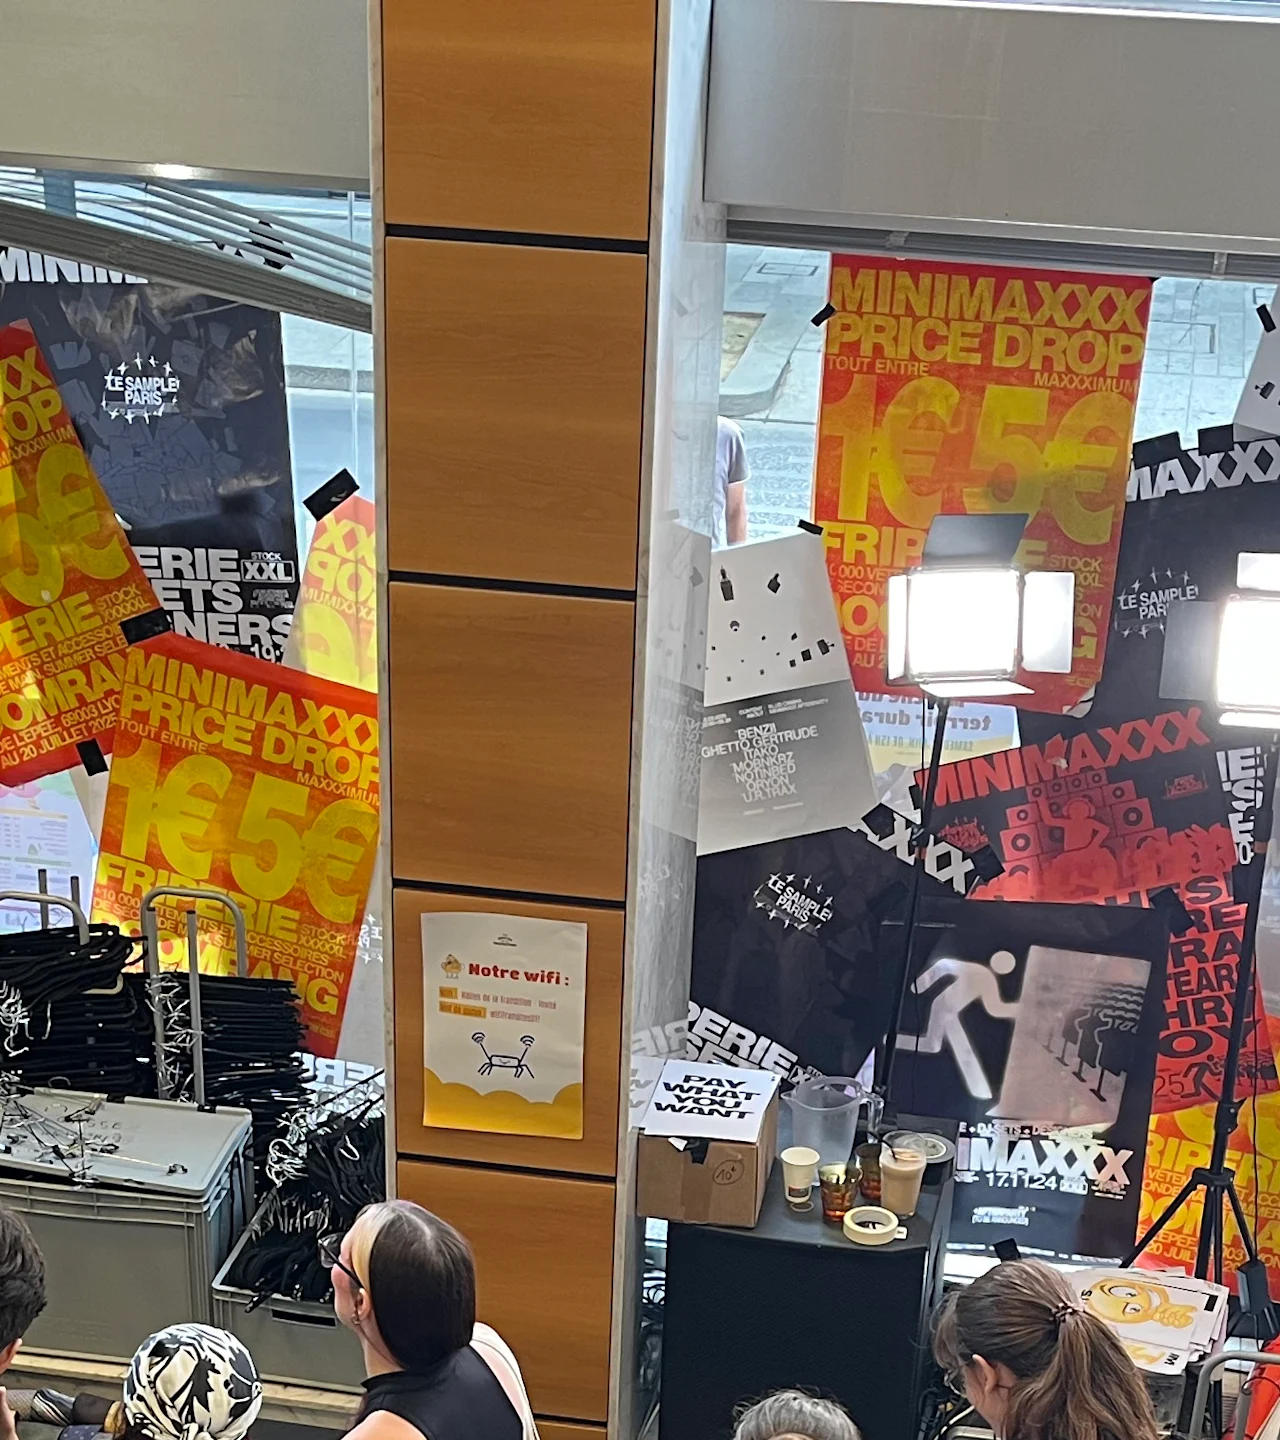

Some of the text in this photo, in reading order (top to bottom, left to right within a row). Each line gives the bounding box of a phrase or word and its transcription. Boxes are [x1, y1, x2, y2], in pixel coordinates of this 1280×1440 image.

[830, 267, 1149, 332] MINIMAXXX
[826, 312, 1148, 376] PRICE DROP
[827, 355, 930, 376] TOUT ENTRE
[107, 375, 177, 393] LE SAMPLE
[1034, 372, 1138, 393] MAXXXIMUM
[125, 391, 162, 406] PARIS
[820, 374, 1137, 545] 1€ 5€
[251, 551, 281, 561] STOCK
[1049, 555, 1102, 571] STOCK
[243, 561, 295, 582] XXL
[95, 583, 142, 610] STOCK
[1119, 586, 1196, 611] LE SAMPLE
[41, 649, 56, 663] ET
[44, 648, 96, 679] SUMMER
[62, 702, 98, 727] 69003
[121, 683, 256, 756] PRICE
[1, 750, 20, 768] AU
[21, 744, 40, 761] 20
[41, 725, 87, 754] JUILLET
[119, 718, 209, 755] TOUT ENTRE
[701, 726, 818, 758] GHETTO GERTRUDE
[230, 772, 380, 925] 5€
[768, 876, 831, 923] LE SAMPLE
[776, 896, 810, 923] PARIS
[94, 900, 345, 984] DE SELECTION
[300, 923, 346, 946] STOCK
[469, 963, 561, 985] Notre wifi
[663, 1082, 761, 1101] WHAT
[683, 1075, 747, 1089] PAY
[654, 1102, 754, 1119] WANT
[673, 1094, 742, 1109] YOU
